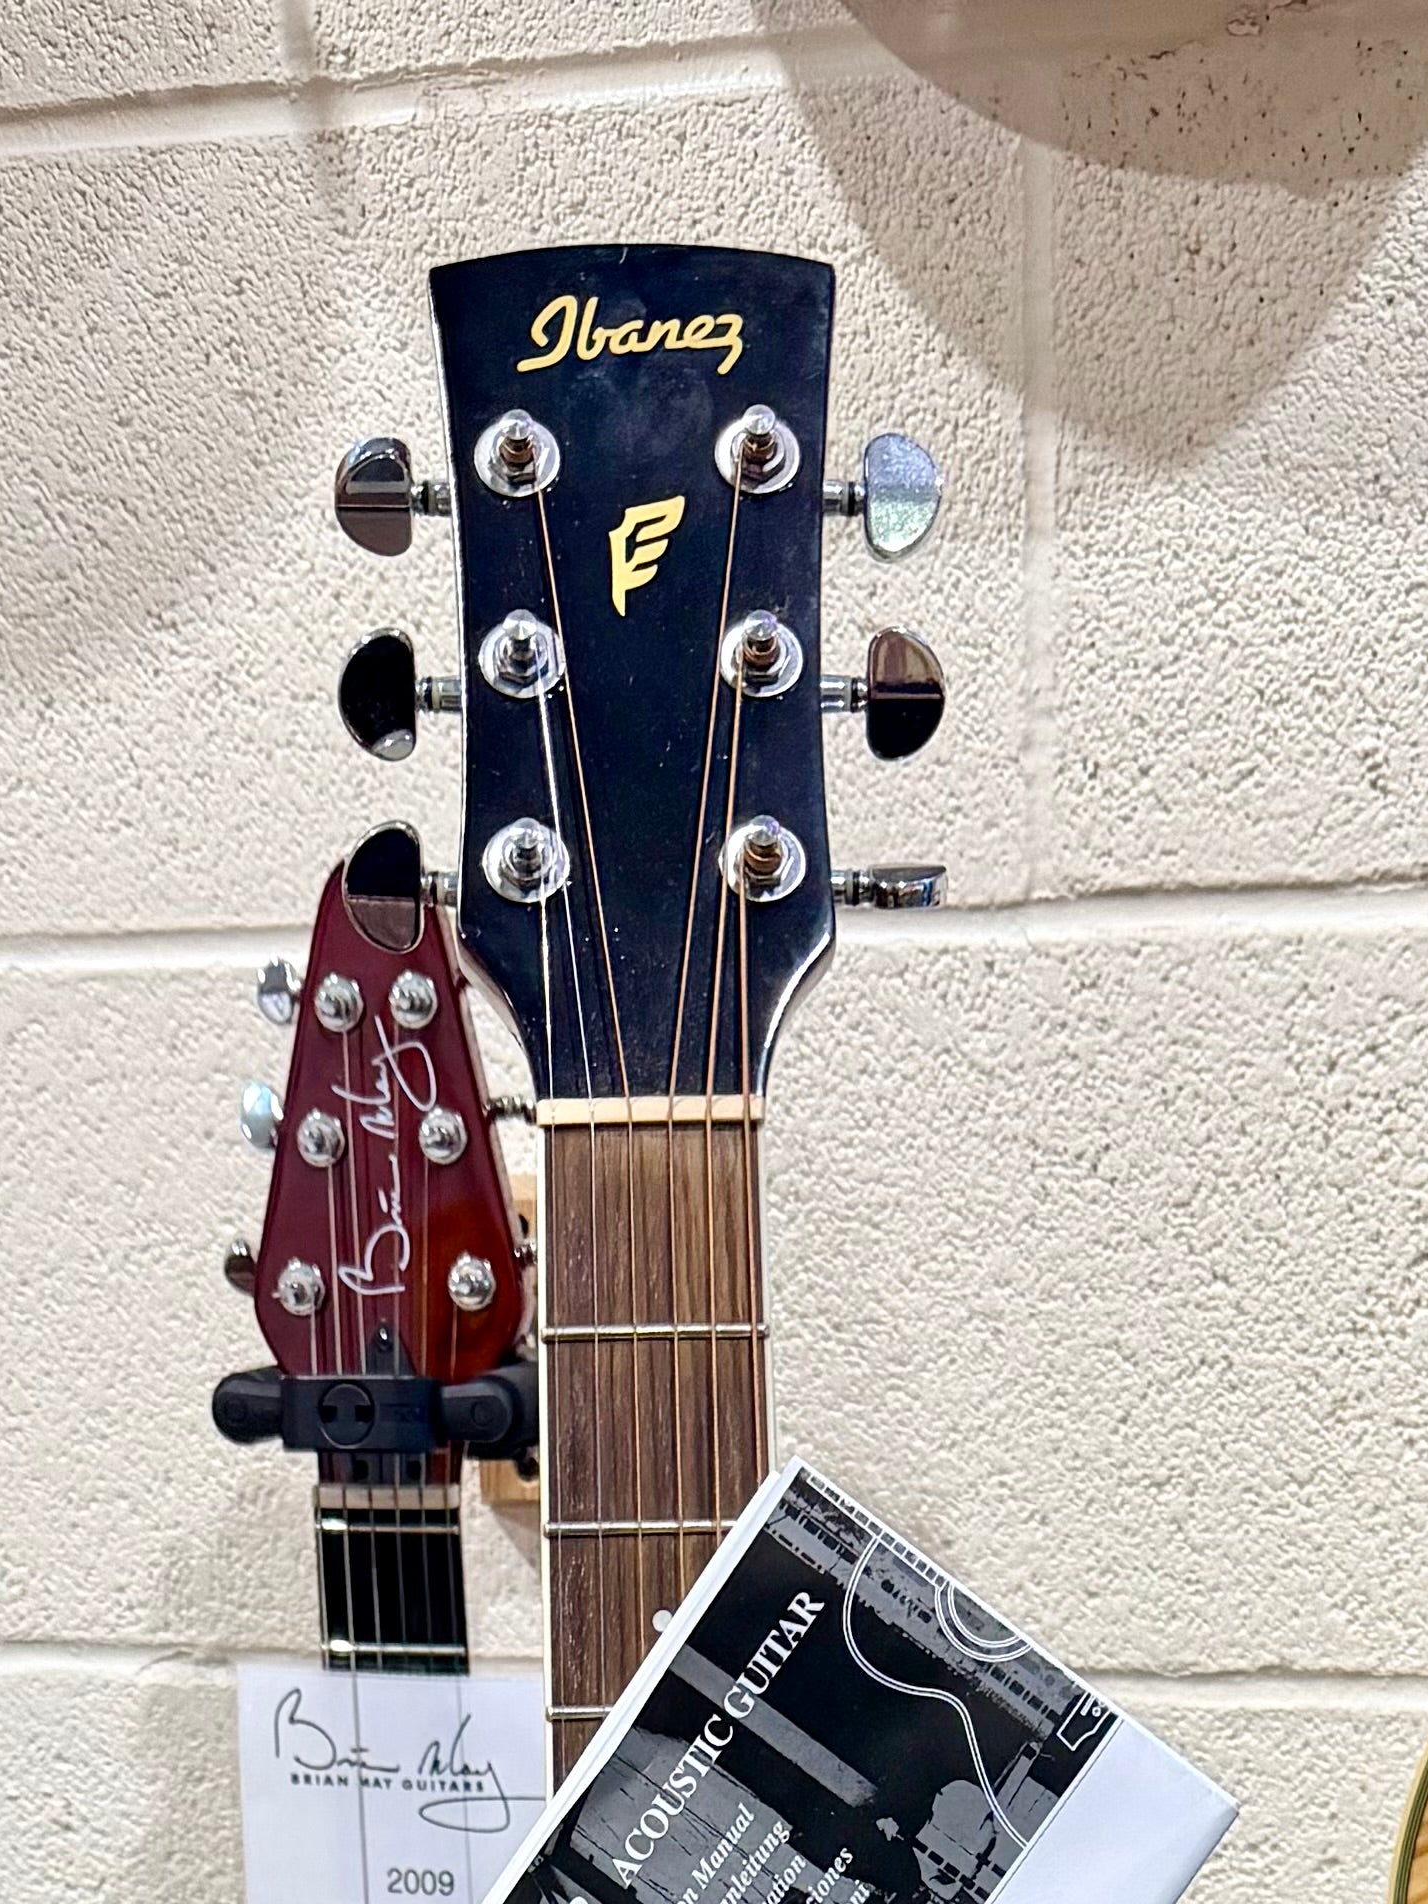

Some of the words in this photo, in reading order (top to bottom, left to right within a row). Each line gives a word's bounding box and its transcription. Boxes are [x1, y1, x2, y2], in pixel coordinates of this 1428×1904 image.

[516, 294, 743, 375] Ibanez
[611, 1714, 735, 1888] ACOUSTIC
[723, 1591, 825, 1720] GUITAR
[290, 1773, 349, 1787] BRIAN
[359, 1777, 393, 1789] MAY
[401, 1778, 484, 1792] GUITARS
[386, 1867, 455, 1897] 2009
[690, 1801, 754, 1890] Manual
